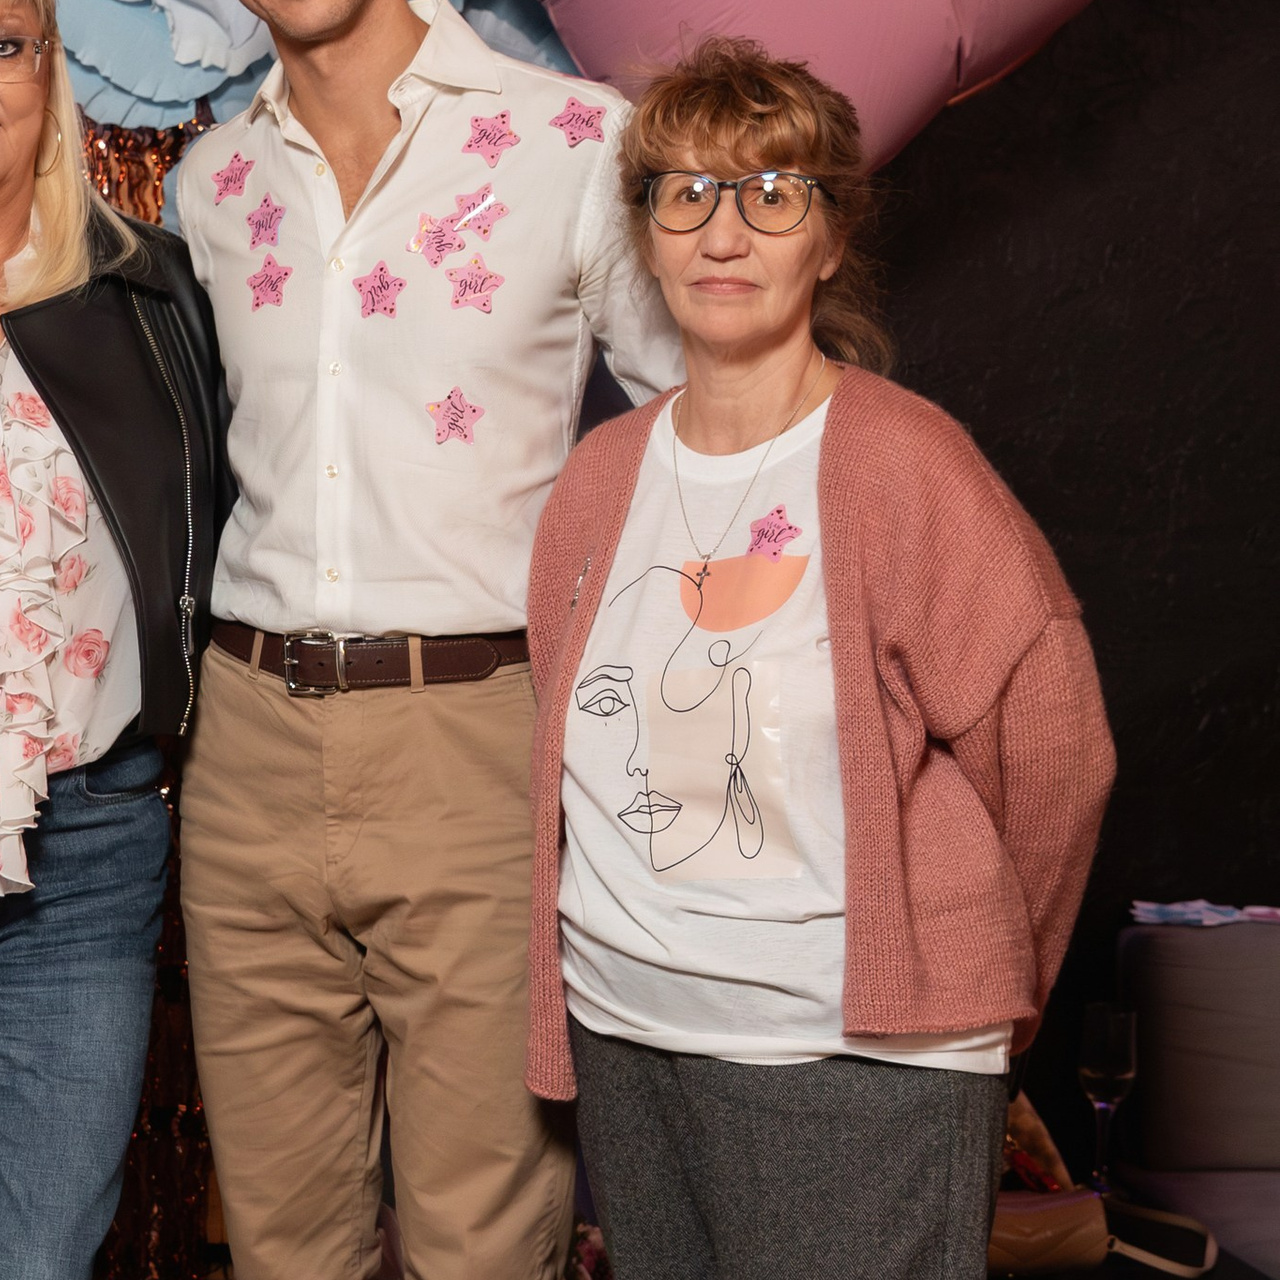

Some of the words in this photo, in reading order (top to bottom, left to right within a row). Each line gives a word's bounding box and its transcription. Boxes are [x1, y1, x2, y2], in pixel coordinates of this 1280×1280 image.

[474, 128, 514, 147] girl
[255, 211, 282, 238] girl
[458, 276, 499, 298] girl
[447, 393, 465, 434] girl
[754, 527, 795, 546] girl
